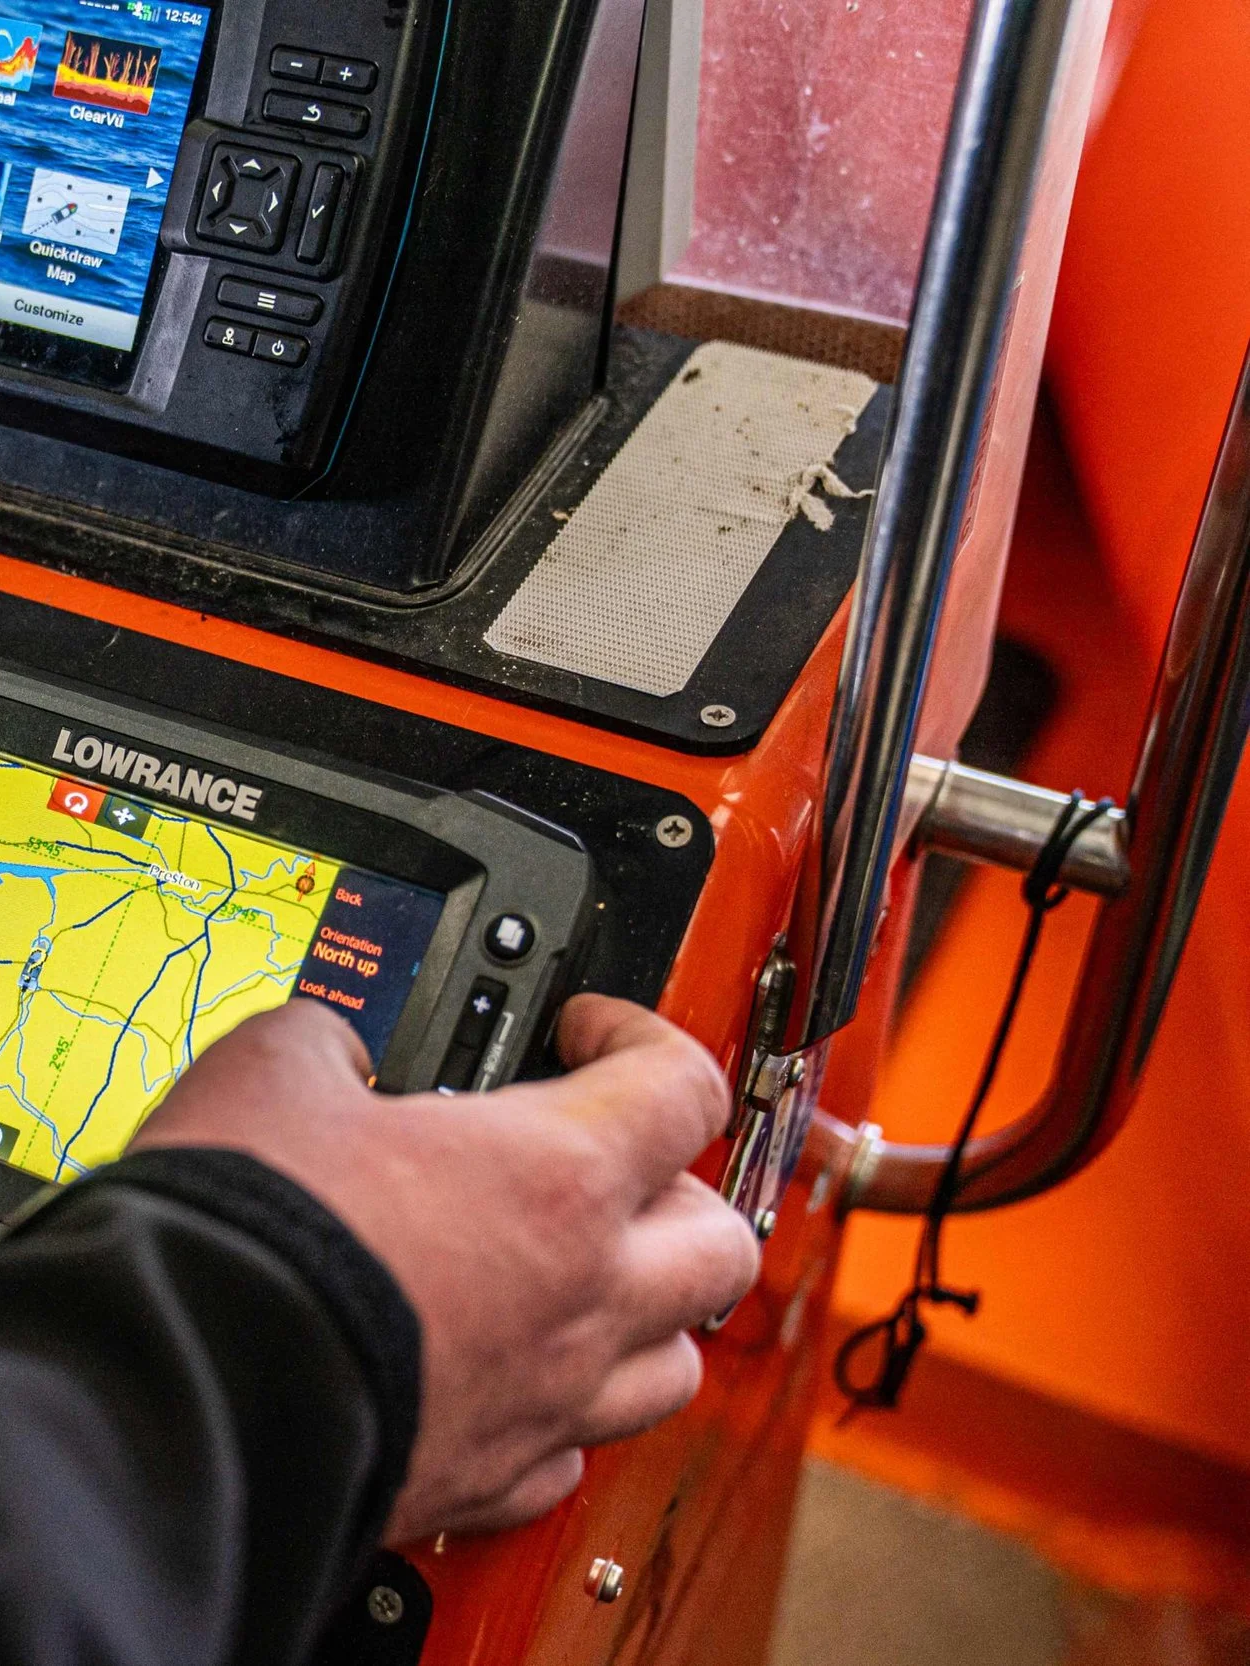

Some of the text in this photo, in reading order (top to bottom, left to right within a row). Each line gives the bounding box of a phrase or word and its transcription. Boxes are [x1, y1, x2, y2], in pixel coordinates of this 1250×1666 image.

[165, 9, 197, 25] 12:54
[29, 240, 103, 269] Quickdraw
[46, 263, 76, 286] Map
[14, 299, 84, 326] Customize
[52, 727, 263, 822] LOWRANCE
[150, 863, 200, 890] Preston
[335, 887, 363, 907] Back
[320, 926, 383, 957] Orientation
[312, 941, 379, 979] North up
[299, 978, 366, 1010] Look ahead
